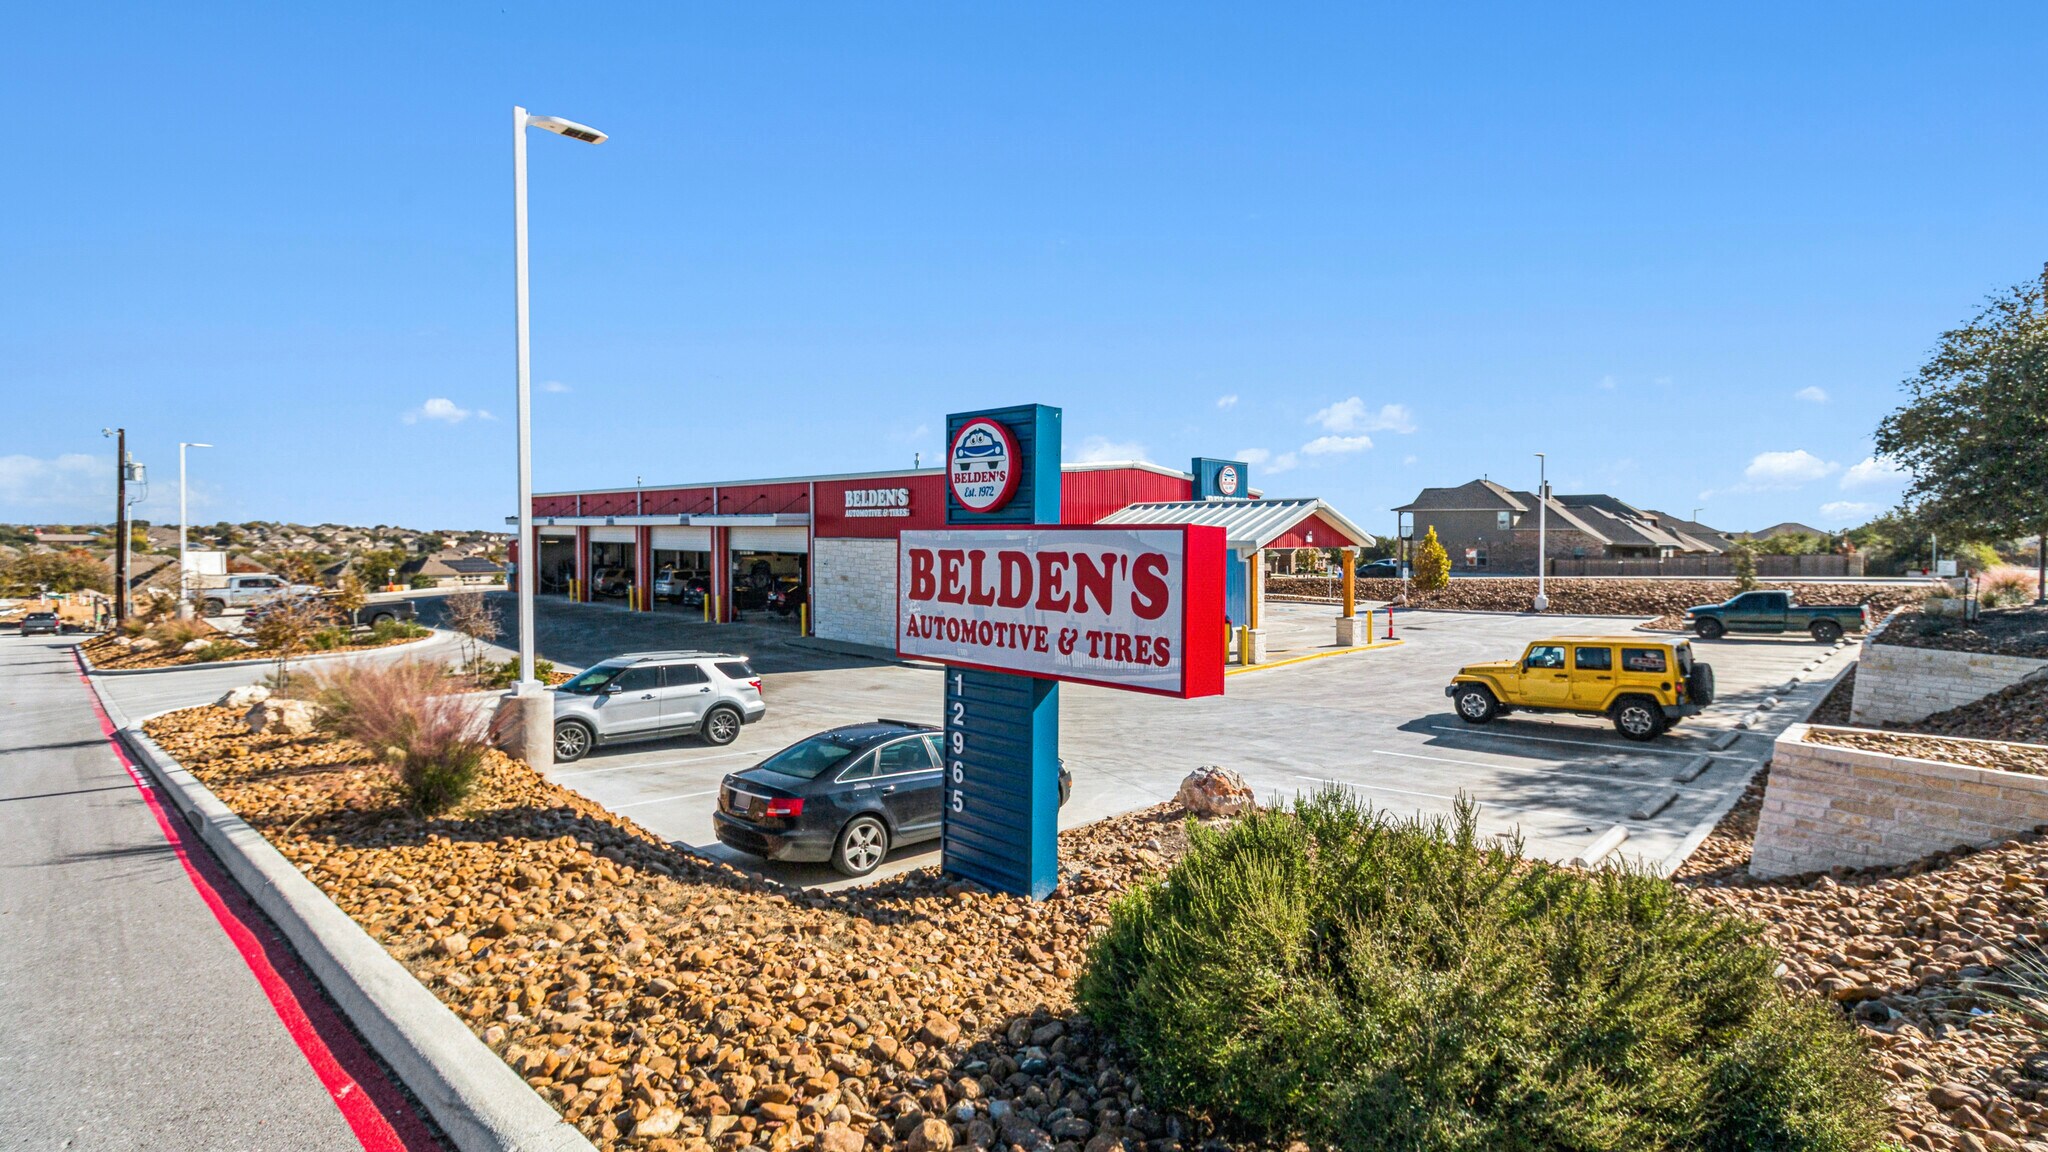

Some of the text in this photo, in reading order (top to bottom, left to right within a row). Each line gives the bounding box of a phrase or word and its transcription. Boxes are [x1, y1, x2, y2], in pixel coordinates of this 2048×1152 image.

[954, 471, 1006, 484] BELDEN'S
[844, 488, 909, 507] BELDEN'S
[964, 486, 995, 498] Est. 1972
[845, 508, 910, 518] AUTOMOTIVE & TIRES
[908, 548, 1169, 620] BELDEN'S
[906, 614, 1171, 667] AUTOMOTIVE & TIRES
